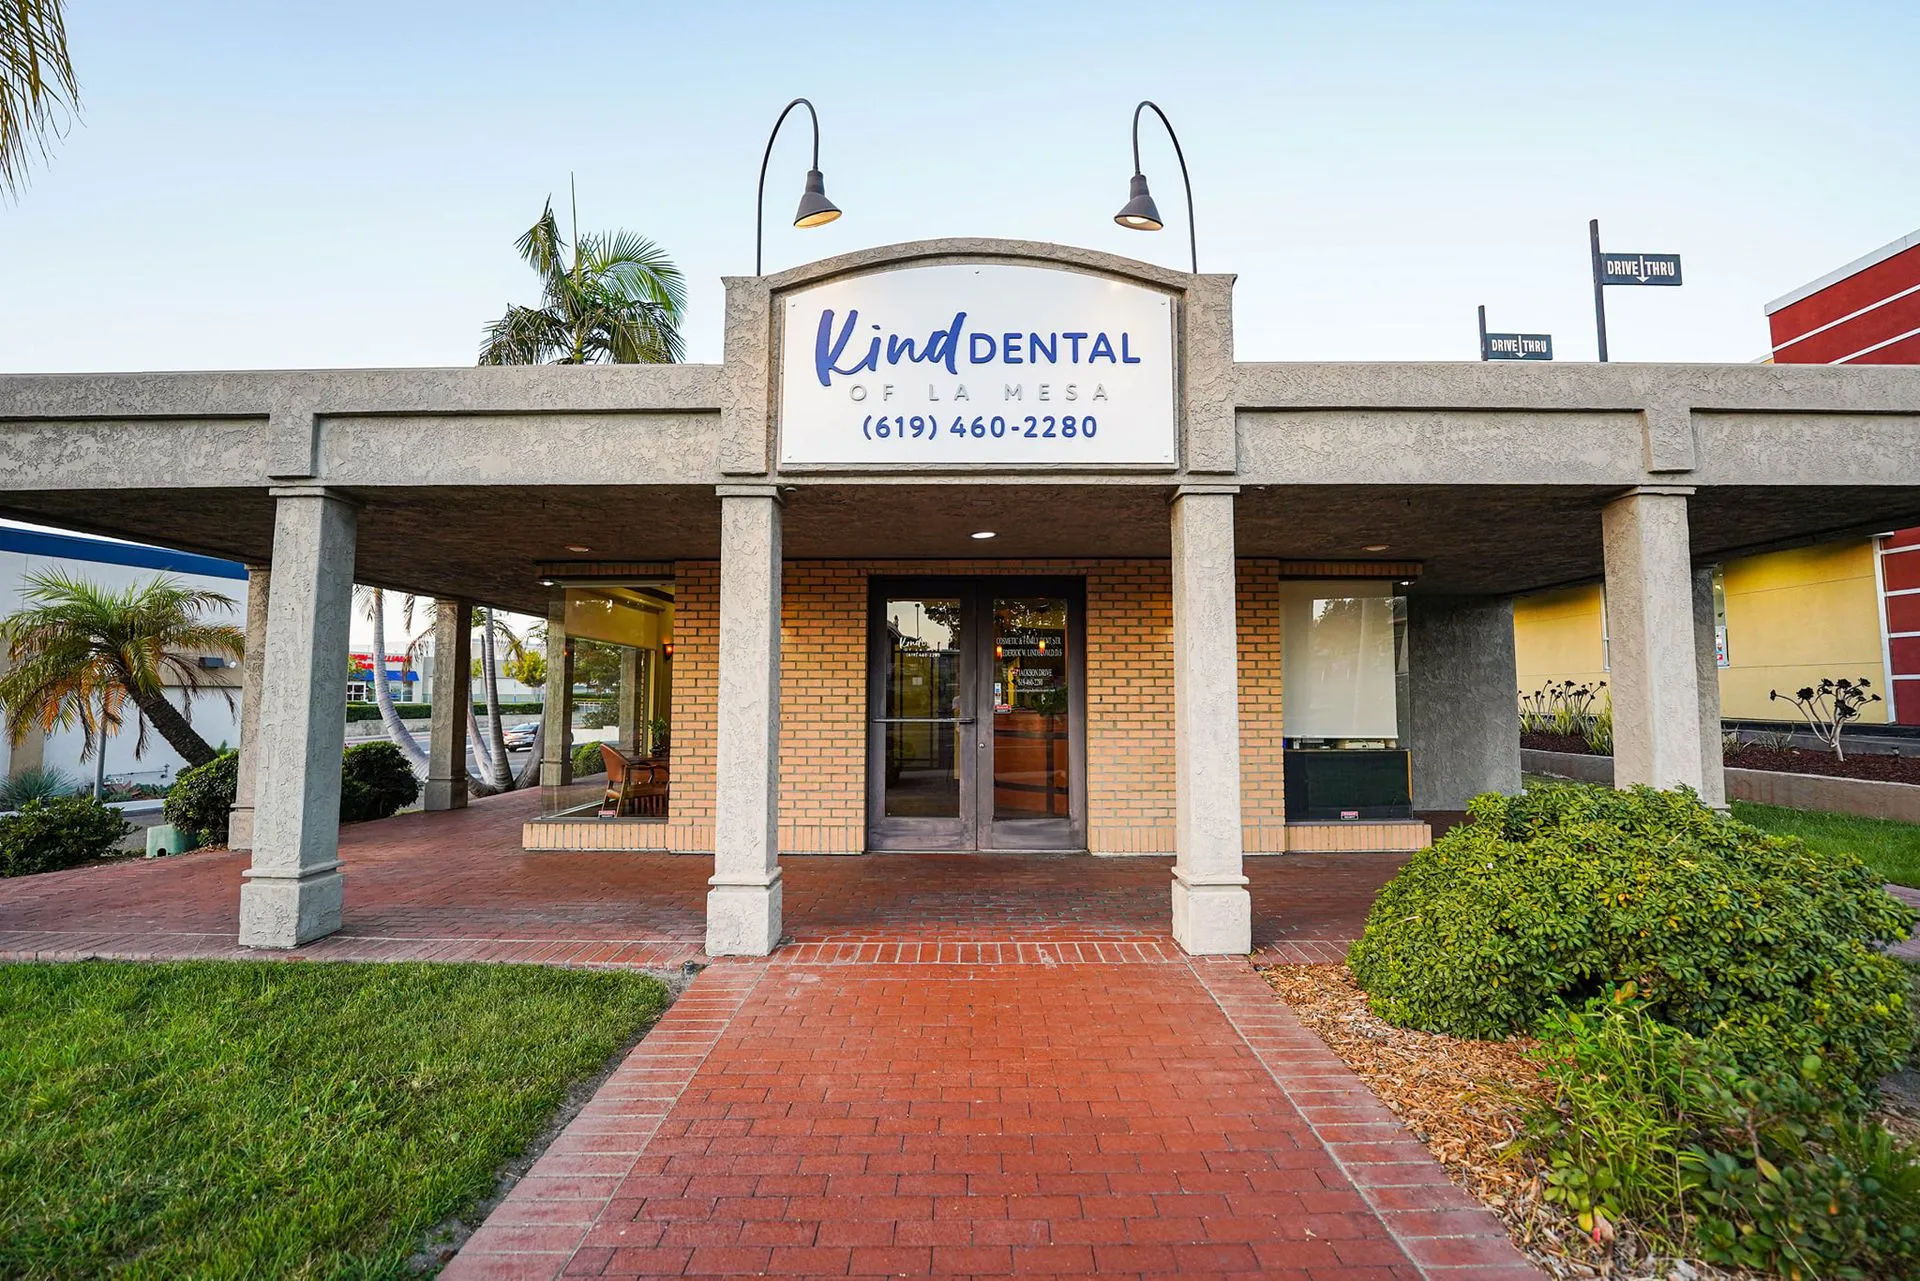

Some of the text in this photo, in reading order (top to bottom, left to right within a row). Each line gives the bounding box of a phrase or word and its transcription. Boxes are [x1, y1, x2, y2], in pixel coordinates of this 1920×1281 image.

[1606, 260, 1675, 277] DRIVE THRU
[815, 309, 1141, 386] Kind DENTAL
[1491, 339, 1547, 353] DRIVE THRU
[849, 383, 1109, 401] OF LA MESA
[863, 414, 1098, 440] (619) 460-2280
